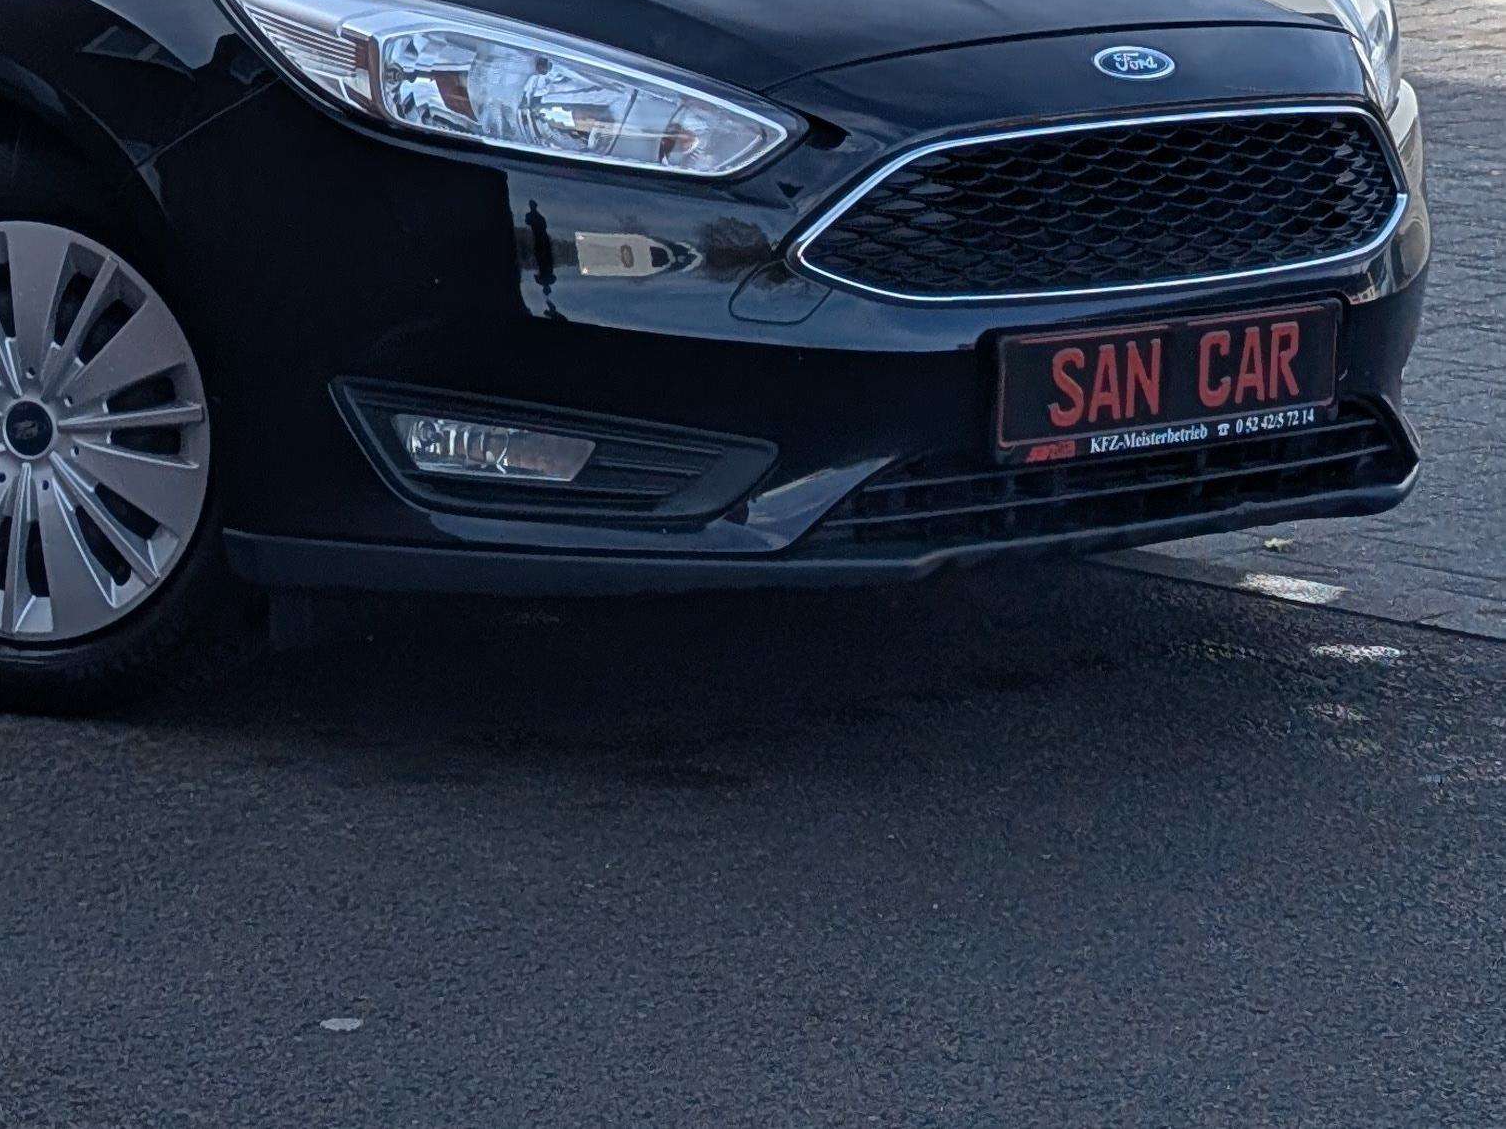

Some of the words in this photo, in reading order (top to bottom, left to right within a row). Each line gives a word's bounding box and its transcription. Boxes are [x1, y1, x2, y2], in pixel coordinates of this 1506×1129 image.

[1112, 52, 1158, 72] Ford
[1048, 338, 1162, 428] SAN
[1198, 320, 1300, 408] CAR
[1090, 423, 1209, 454] KFZ-Meisterbetrieb
